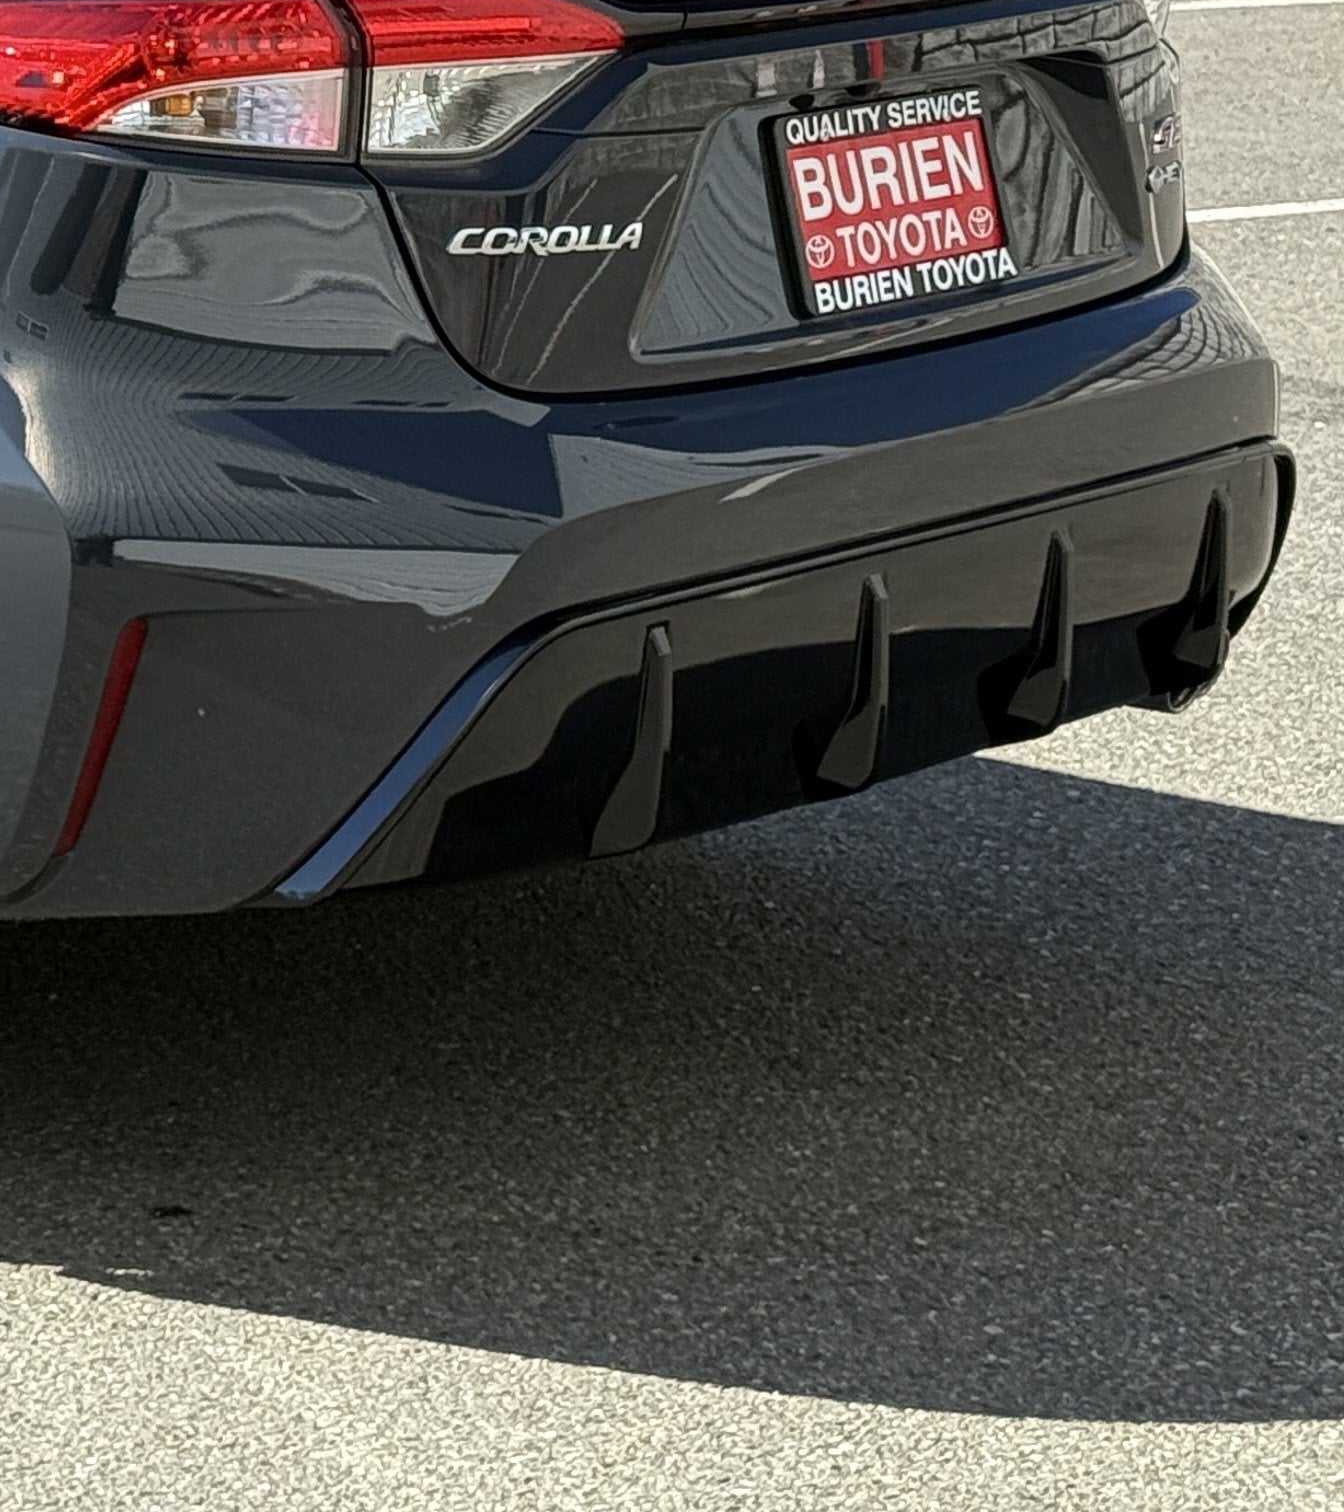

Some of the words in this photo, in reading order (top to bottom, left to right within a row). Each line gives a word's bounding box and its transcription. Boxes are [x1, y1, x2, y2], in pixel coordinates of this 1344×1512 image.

[786, 107, 882, 145] QUALITY
[888, 91, 982, 128] SERVICE
[792, 131, 984, 222] BURIEN
[446, 221, 643, 257] COROLLA
[836, 208, 967, 268] TOYOTA
[814, 269, 912, 314] BURIEN
[916, 247, 1018, 294] TOYOTA
